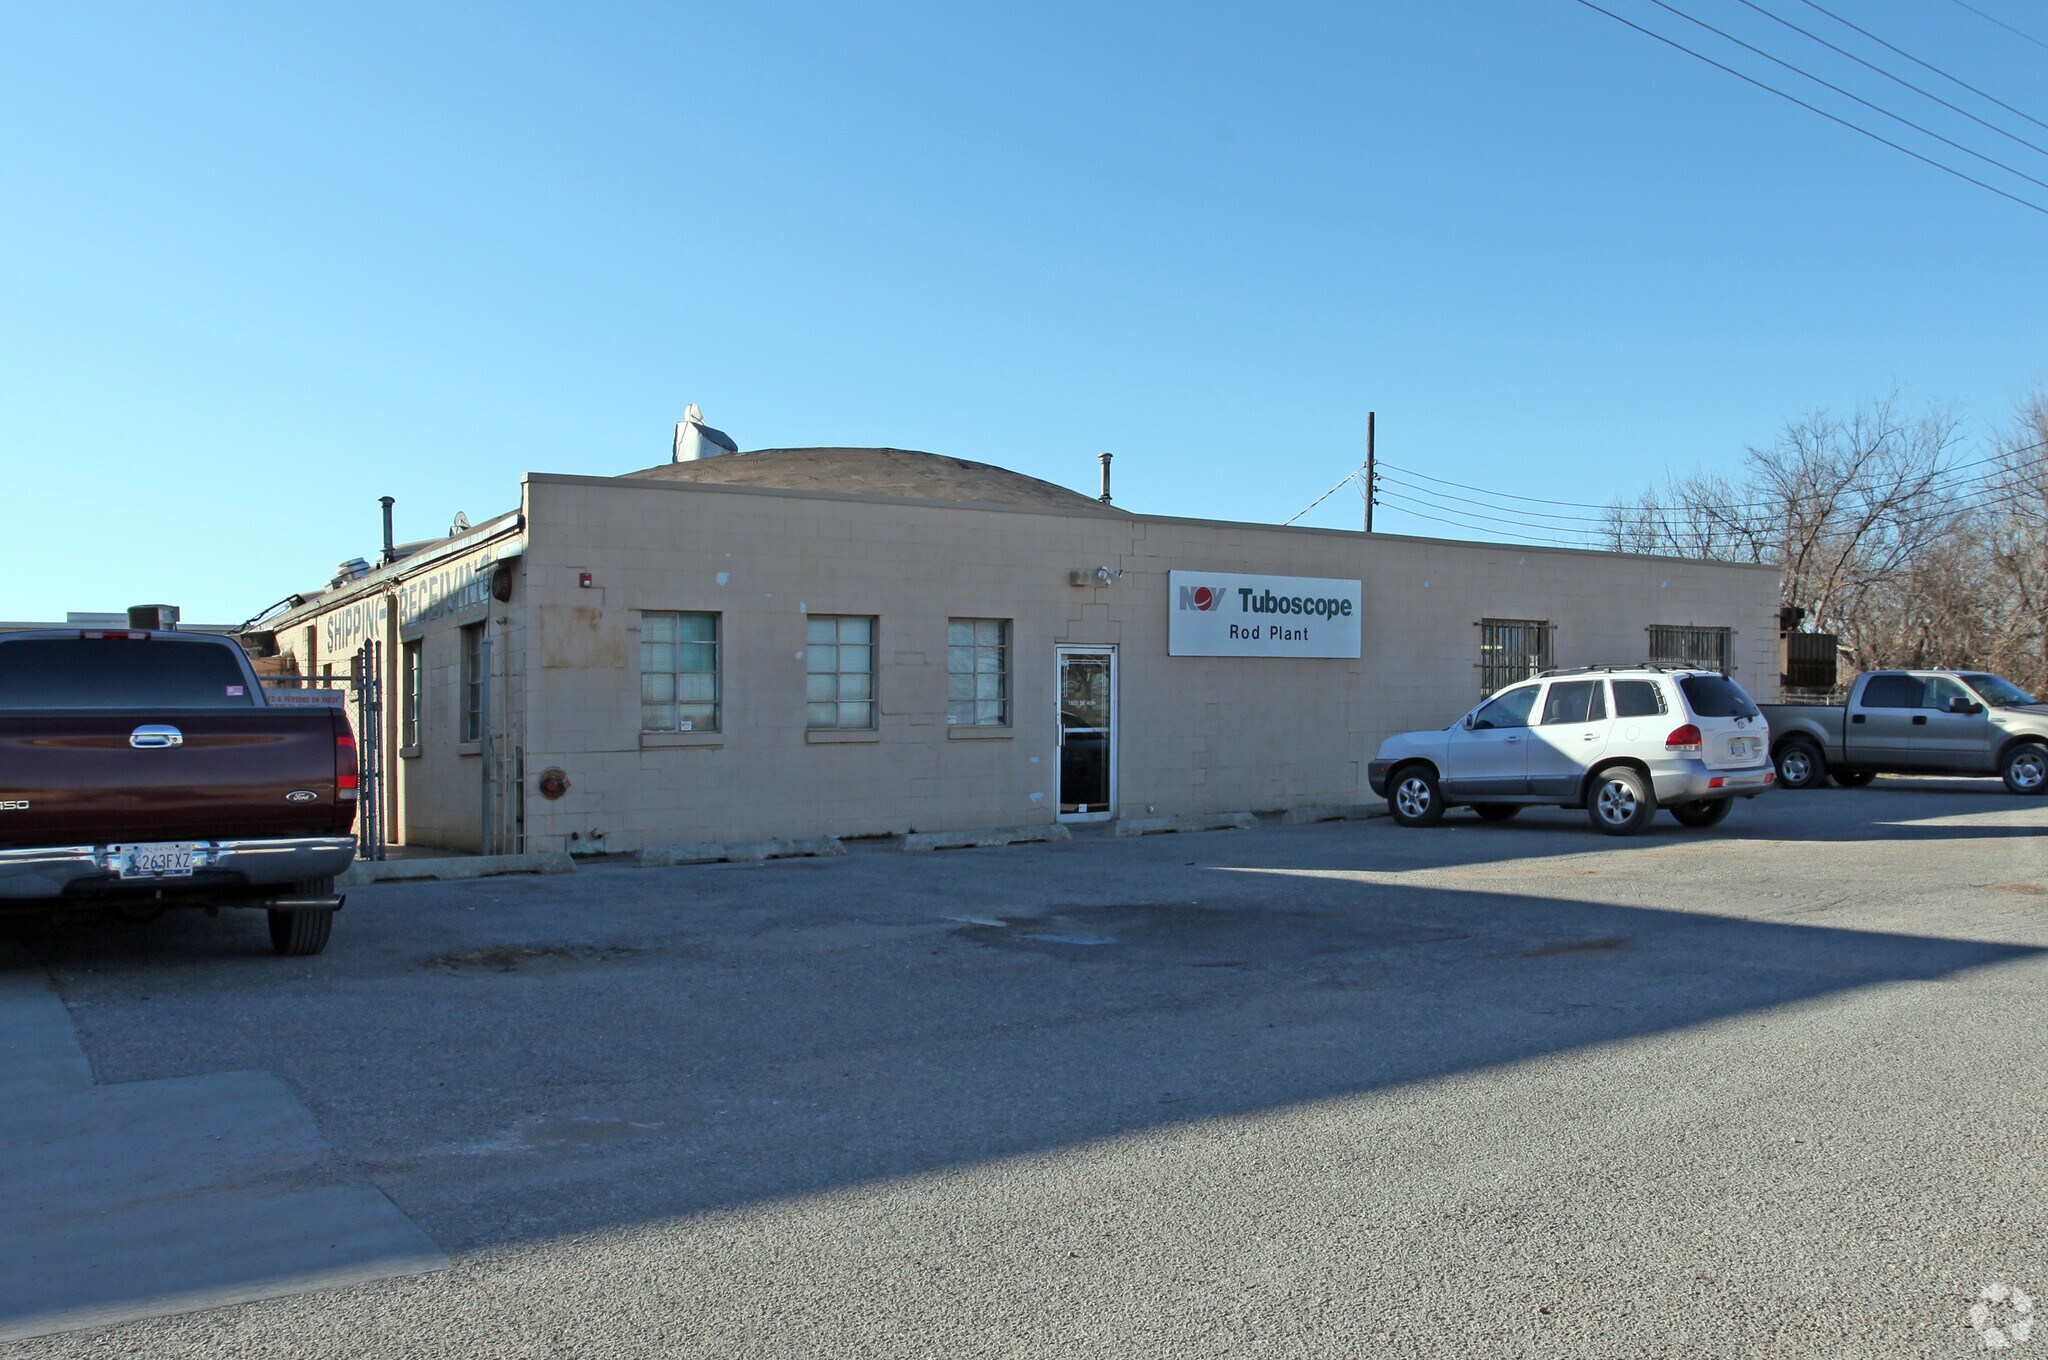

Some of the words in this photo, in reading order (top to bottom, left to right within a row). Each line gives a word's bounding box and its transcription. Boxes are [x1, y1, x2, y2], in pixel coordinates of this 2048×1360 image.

[1238, 588, 1352, 621] Tuboscope
[1229, 624, 1260, 640] Rod
[1270, 625, 1309, 641] Plant
[142, 853, 190, 870] 263FXZ
